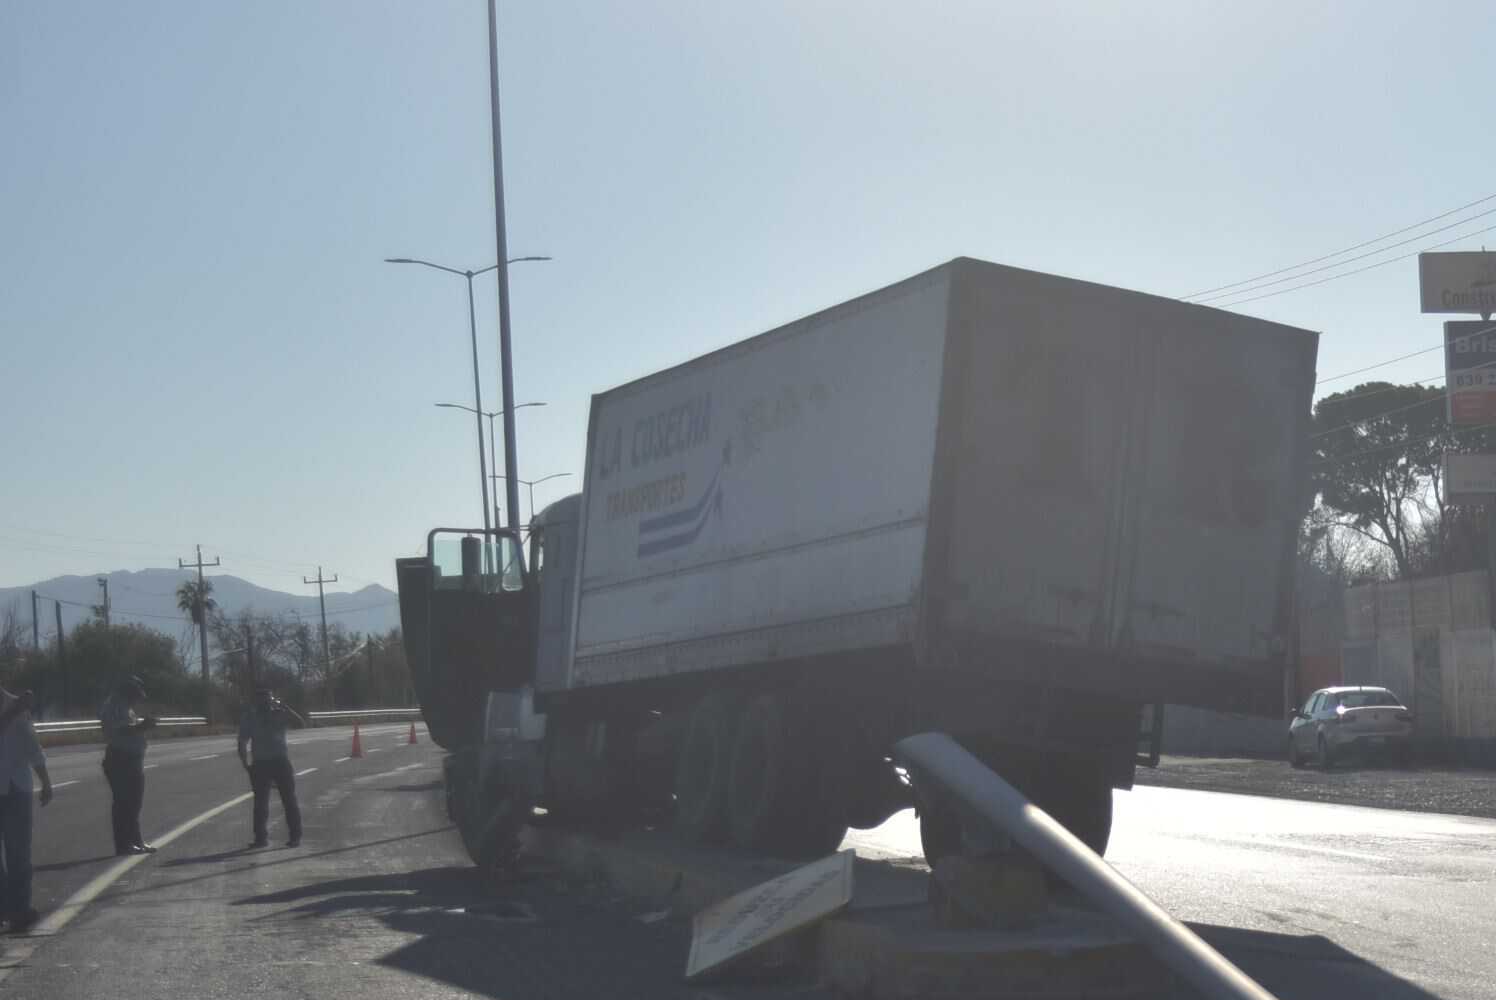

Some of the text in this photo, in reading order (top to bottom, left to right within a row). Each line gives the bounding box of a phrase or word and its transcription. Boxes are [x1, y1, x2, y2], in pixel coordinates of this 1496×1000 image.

[599, 425, 623, 482] LA
[631, 392, 713, 469] COSECHA
[605, 472, 687, 521] TRANSPORTES
